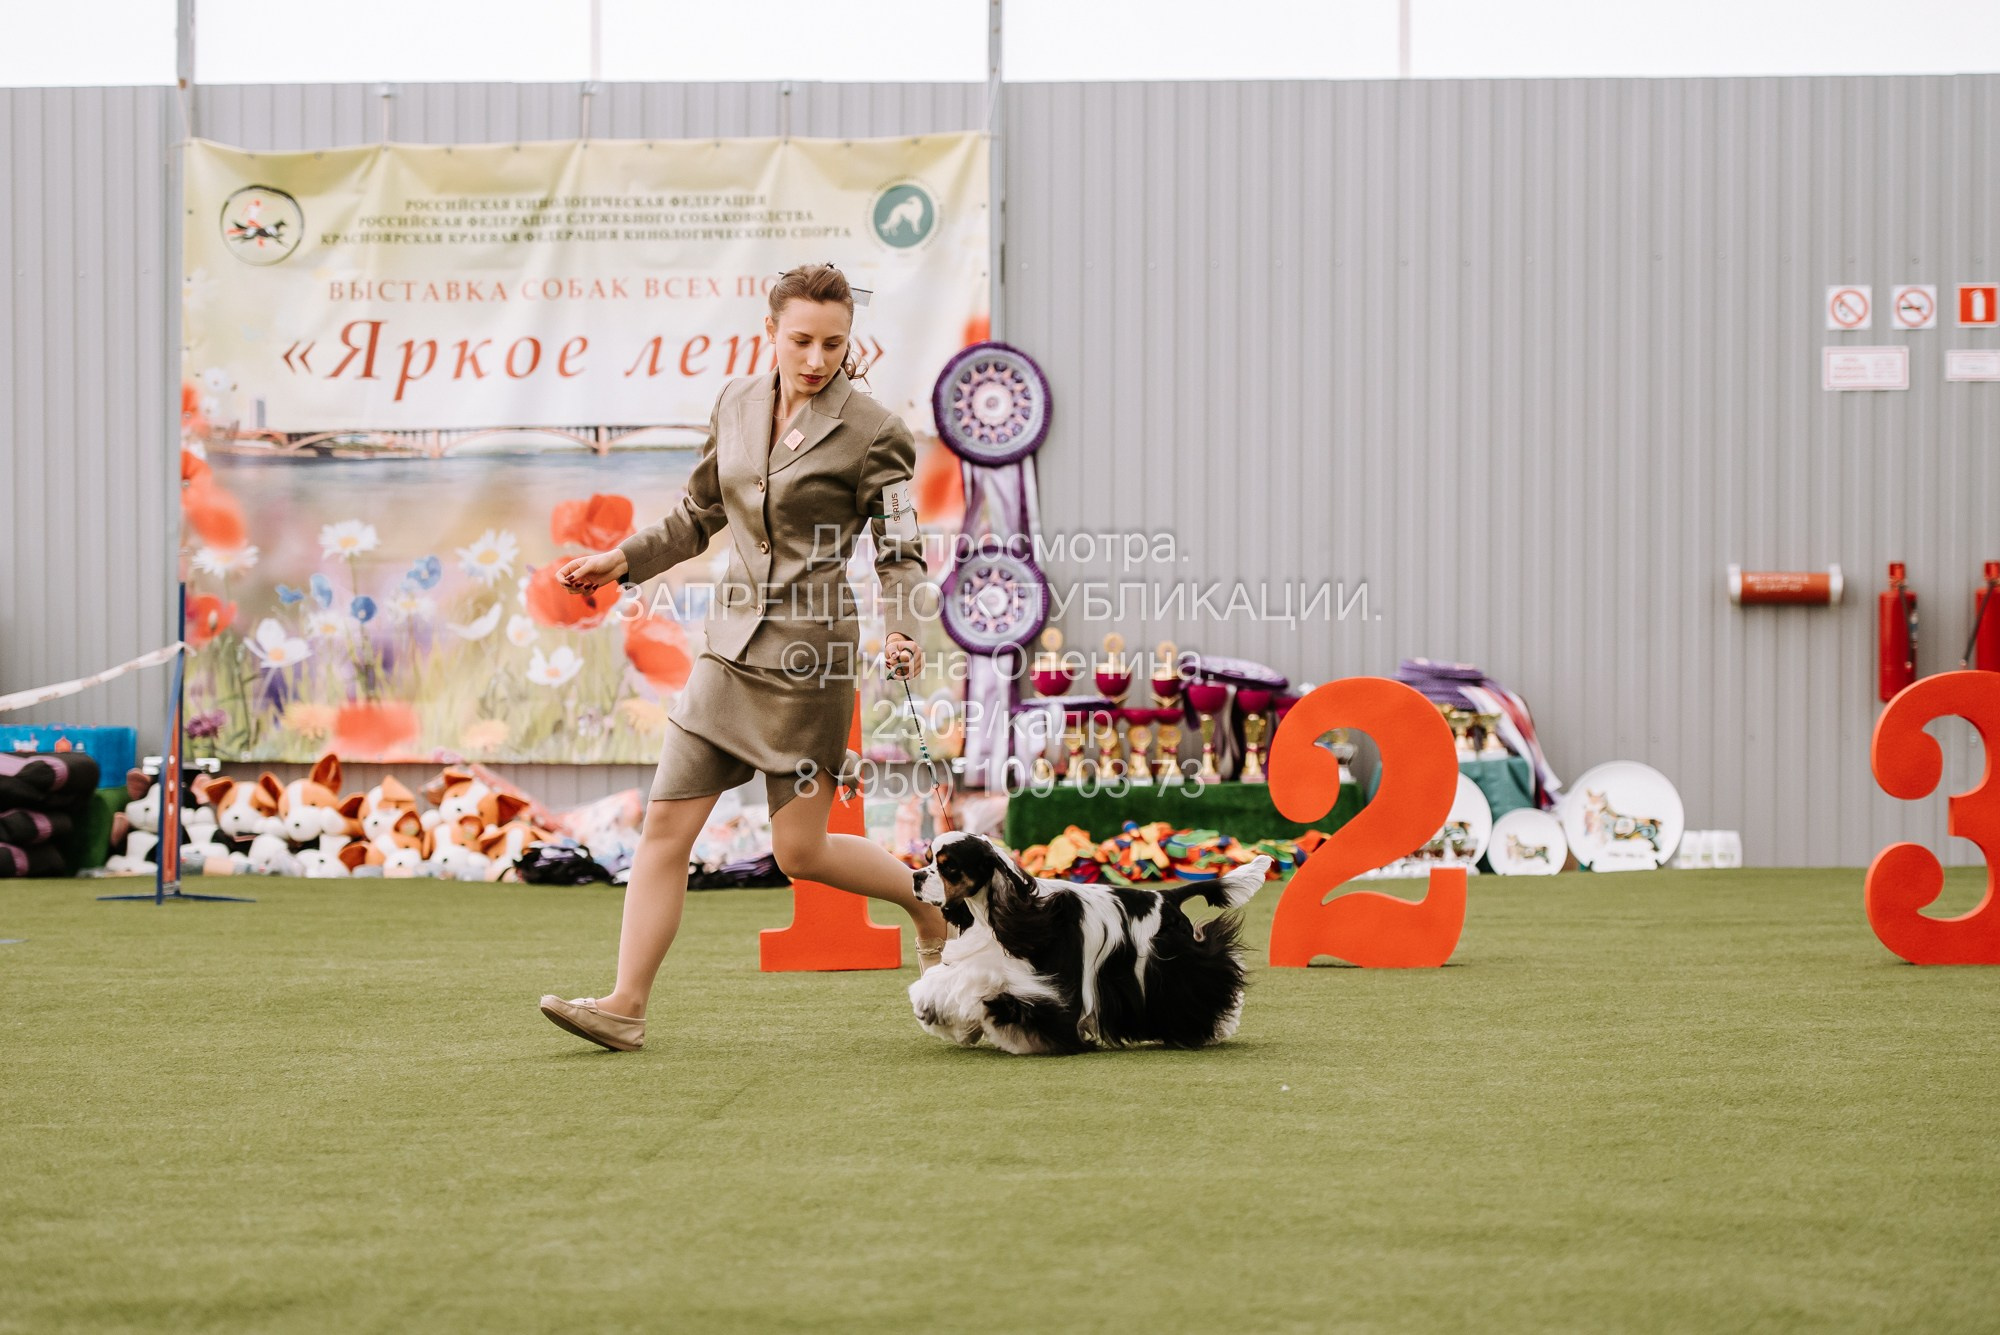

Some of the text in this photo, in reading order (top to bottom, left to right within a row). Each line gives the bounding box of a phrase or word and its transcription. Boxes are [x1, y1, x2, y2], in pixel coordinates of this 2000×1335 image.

[405, 194, 767, 211] РОССИЙСКАЯ КИНОЛОГИЧЕСКАЯ ФЕДЕРАЦИЯ
[358, 210, 814, 228] РОССИЙСКАЯ ФЕДЕРАЦИЯ СЛУЖЕБНОГО СОБАКОВОДСТВА
[321, 226, 852, 245] КРАСНОЯРСКАЯ КРАЕВАЯ ФЕДЕРАЦИЯ КИНОЛОГИЧЕСКОГО СПОРТА
[329, 280, 508, 303] ВЫСТАВКА
[521, 277, 629, 302] СОБАК
[645, 276, 722, 300] ВСЕХ
[282, 318, 885, 402] «Яркое лет»
[1268, 676, 1468, 969] 2
[1865, 670, 2000, 967] 3
